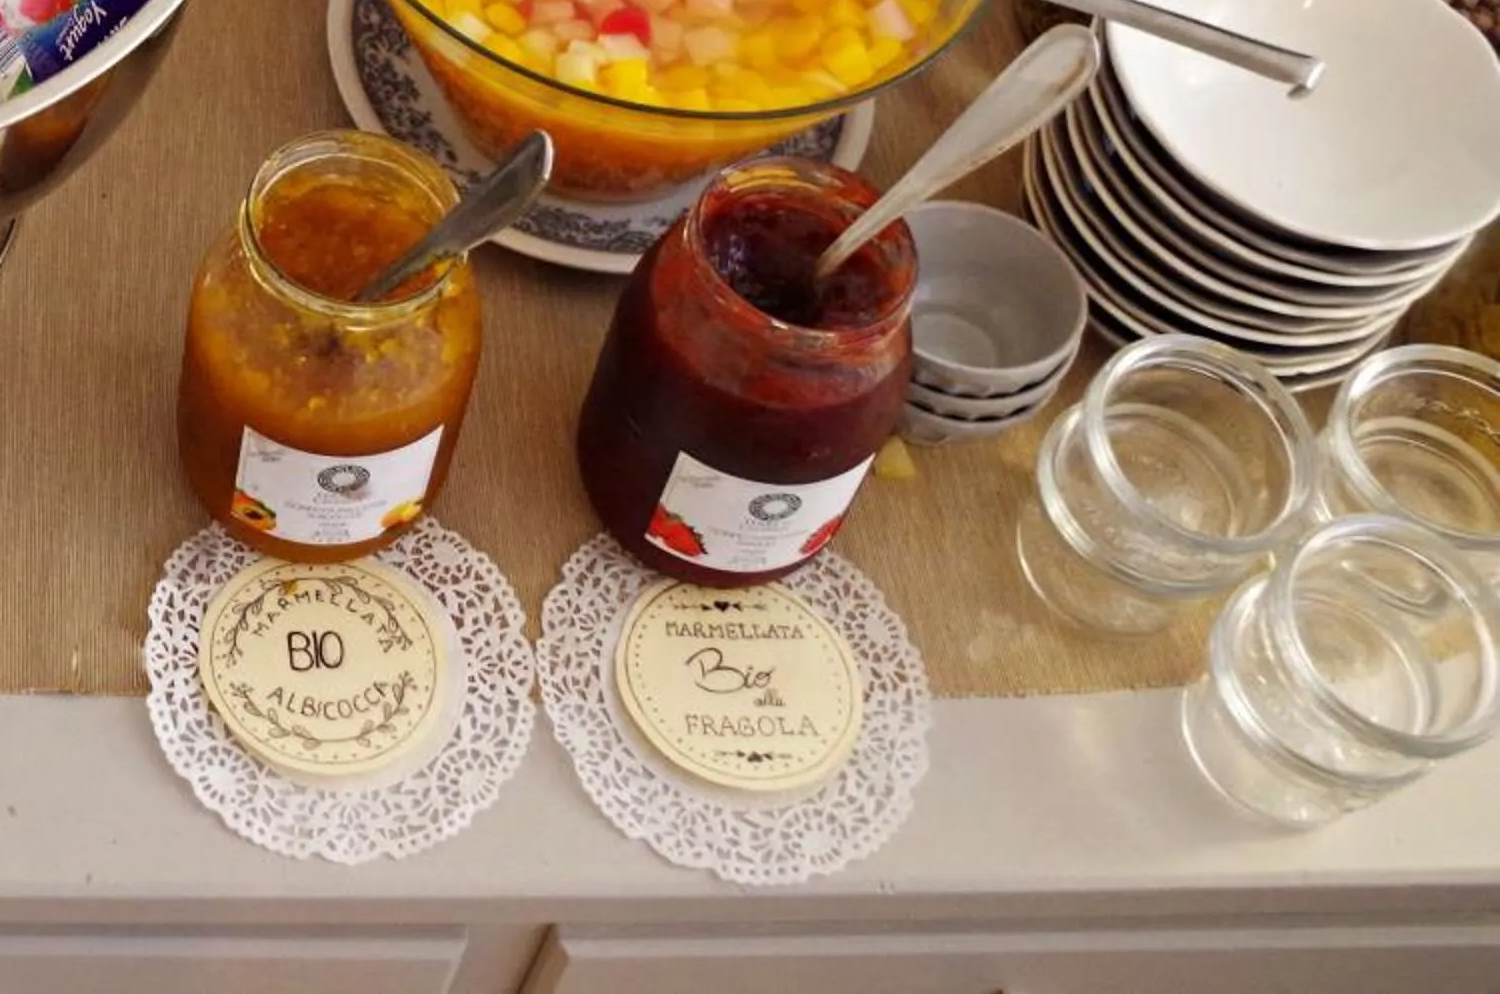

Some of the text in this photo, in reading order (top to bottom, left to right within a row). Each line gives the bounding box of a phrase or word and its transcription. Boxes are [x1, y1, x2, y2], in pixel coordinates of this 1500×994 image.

[60, 0, 108, 62] Yogurt
[253, 587, 394, 653] MARMELLATA
[665, 620, 806, 641] MARMELLATA
[286, 630, 345, 672] BIO
[685, 647, 776, 694] Bio
[267, 680, 391, 722] ALBICOCCA
[684, 714, 821, 737] FRAGOLA
